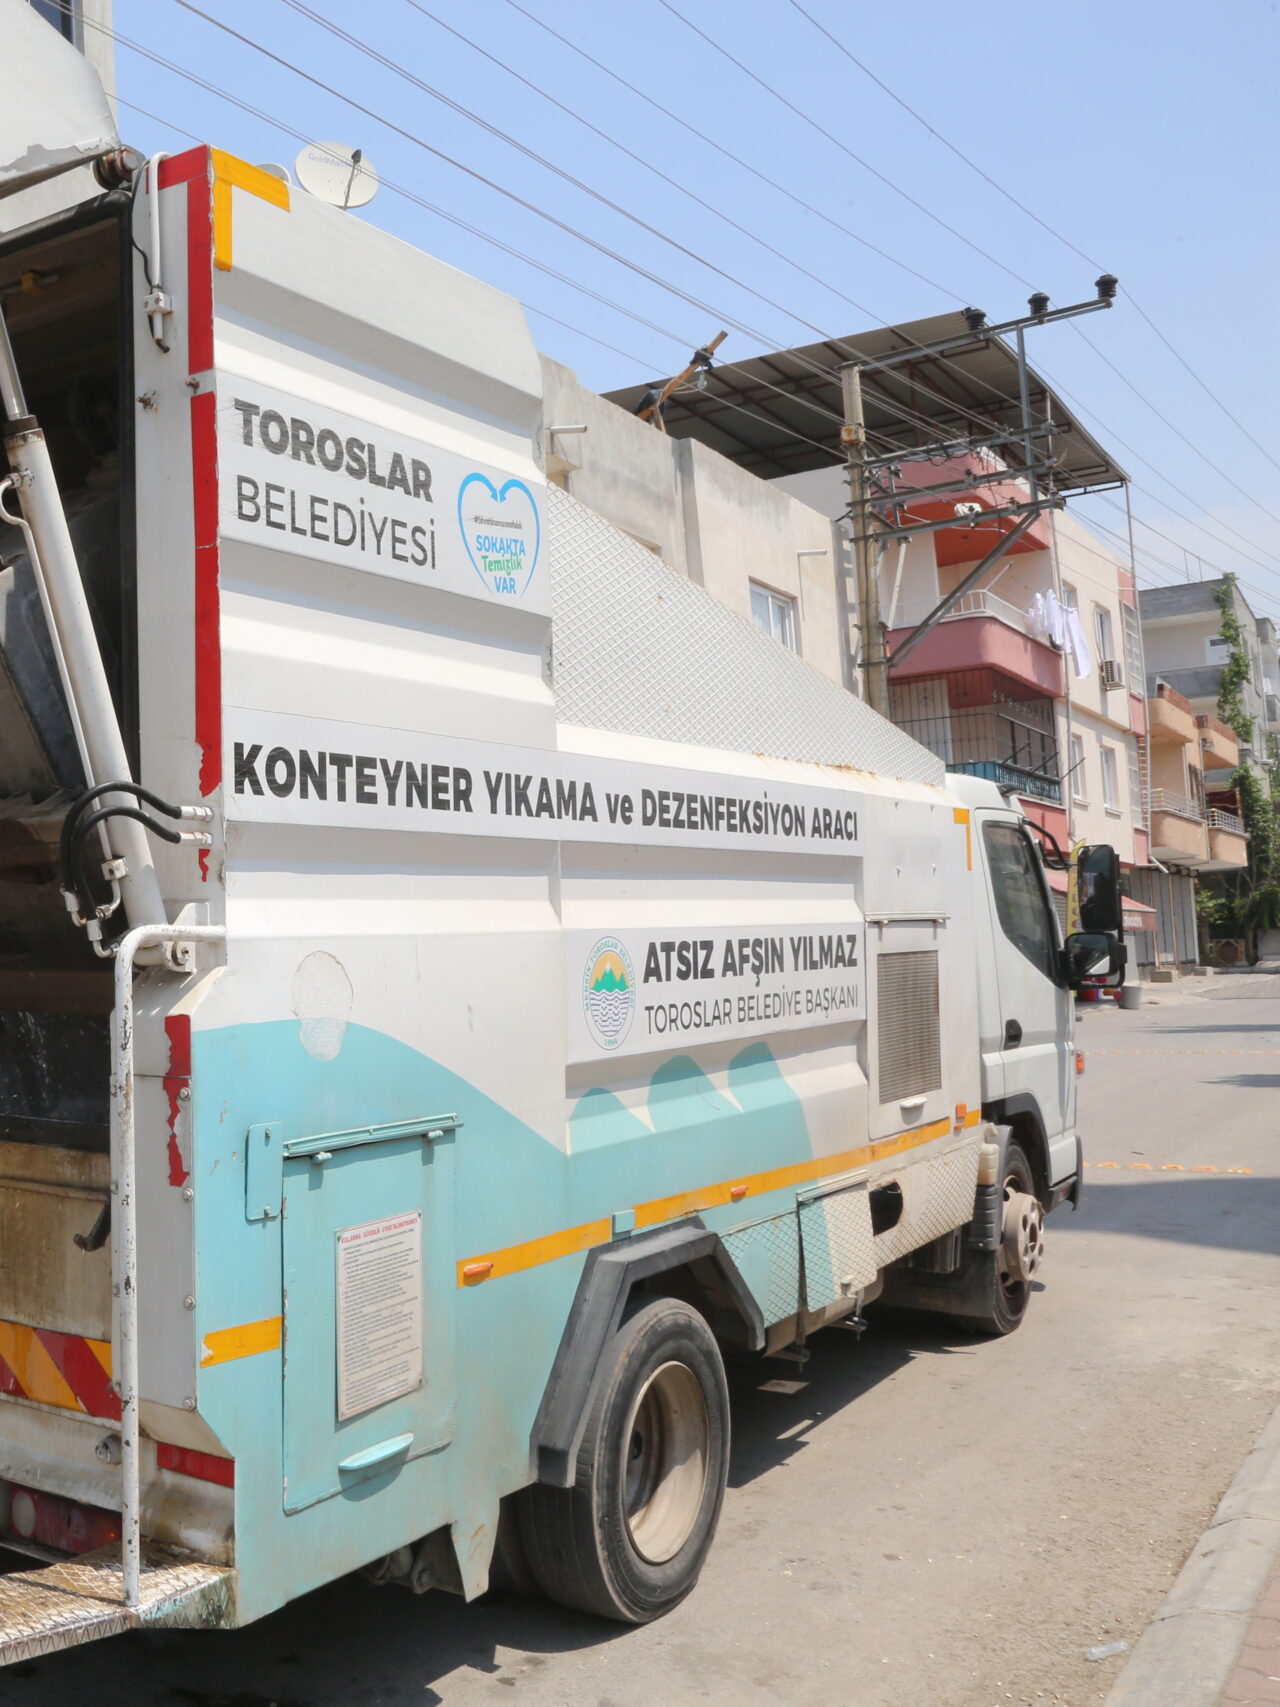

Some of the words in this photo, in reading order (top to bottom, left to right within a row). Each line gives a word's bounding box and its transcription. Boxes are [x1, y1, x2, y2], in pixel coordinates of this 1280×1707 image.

[234, 398, 434, 503] TOROSLAR
[236, 474, 436, 570] BELEDİYESİ
[475, 534, 526, 557] SOKAKTA
[480, 552, 523, 576] Temizlik
[494, 575, 517, 594] VAR
[233, 741, 473, 813] KONTEYNER
[483, 770, 599, 822] YIKAMA
[605, 792, 634, 826] ve
[641, 788, 806, 838] DEZENFEKSİYON
[811, 807, 858, 841] ARACI
[643, 939, 715, 983] ATSIZ
[721, 937, 784, 987] AFŞIN
[789, 934, 858, 972] YILMAZ
[645, 997, 732, 1034] TOROSLAR
[737, 984, 802, 1023] BELEDİYE
[805, 984, 858, 1018] BAŞKANI
